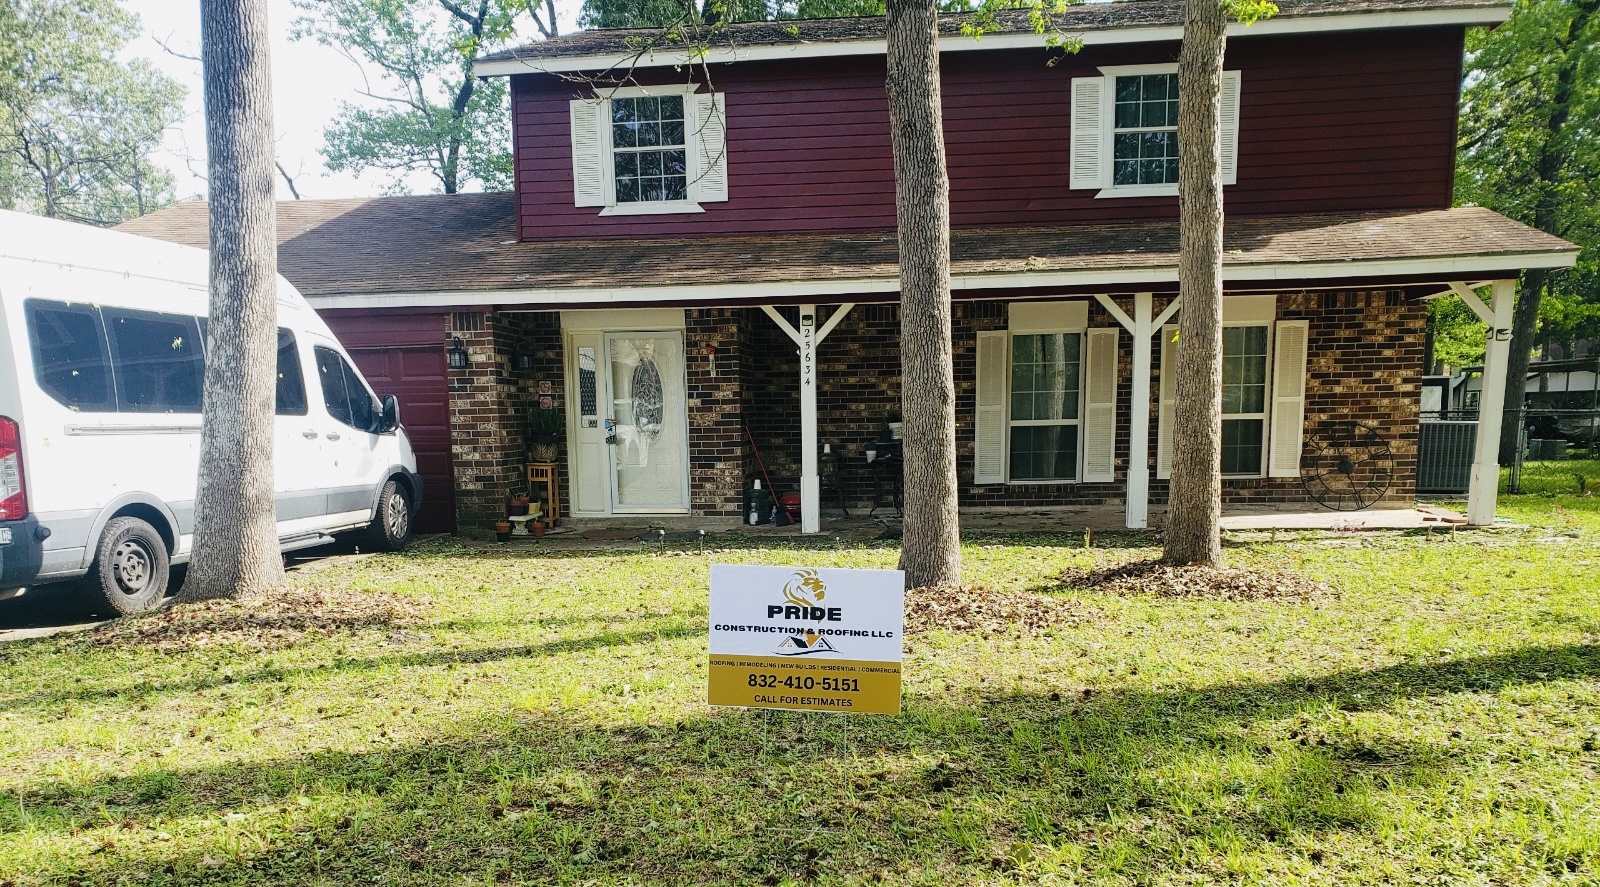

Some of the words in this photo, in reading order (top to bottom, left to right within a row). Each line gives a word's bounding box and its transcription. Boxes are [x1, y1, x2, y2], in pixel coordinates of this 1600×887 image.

[767, 605, 842, 622] PRIDE
[714, 624, 804, 635] CONSTRUCTION
[818, 628, 869, 637] ROOFING
[740, 661, 777, 669] REMODELING
[748, 673, 860, 692] 832-410-5151
[754, 694, 778, 704] CALL
[780, 695, 799, 705] FOR
[800, 697, 853, 707] ESTIMATES
